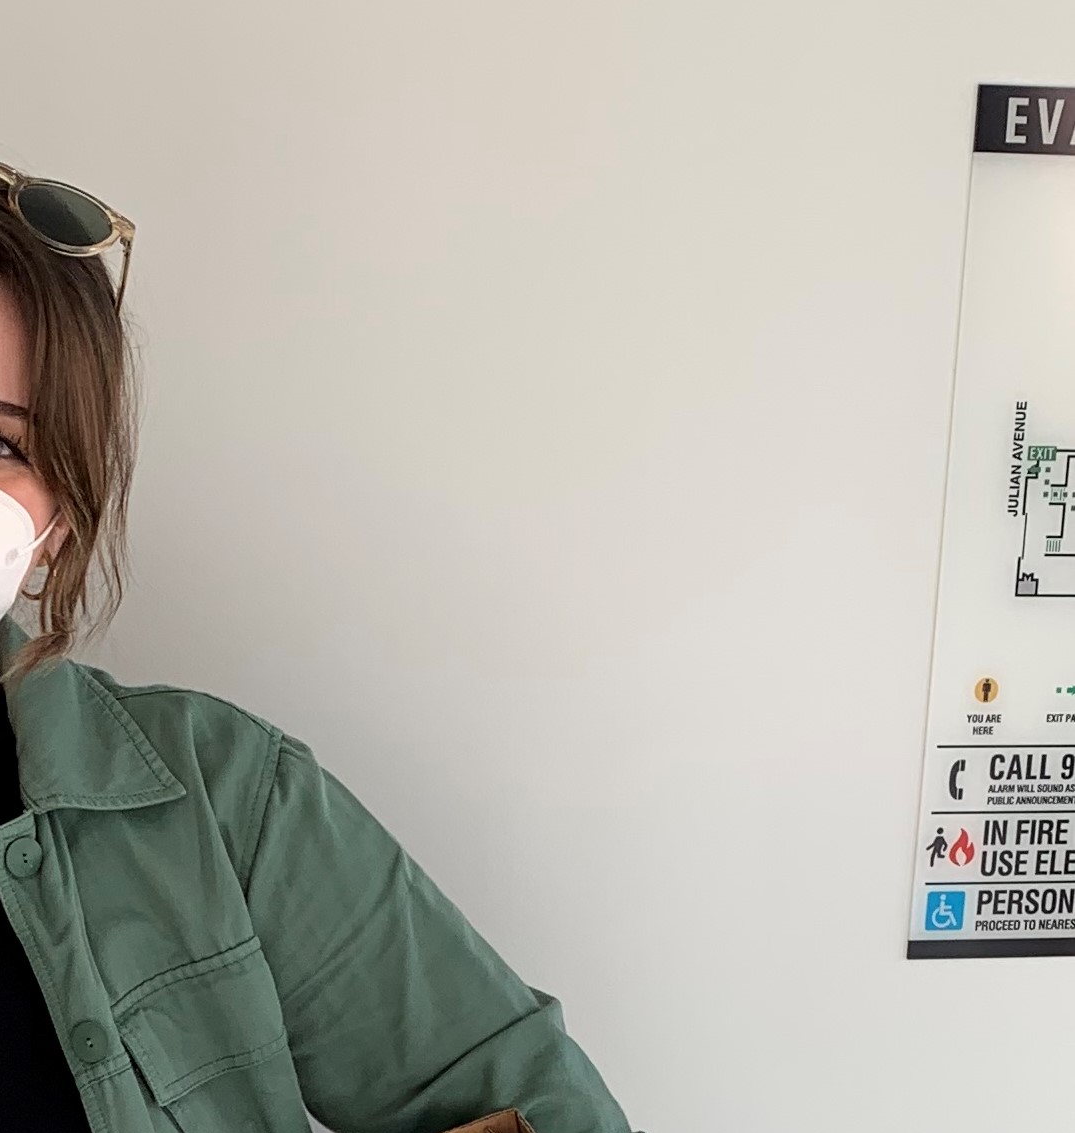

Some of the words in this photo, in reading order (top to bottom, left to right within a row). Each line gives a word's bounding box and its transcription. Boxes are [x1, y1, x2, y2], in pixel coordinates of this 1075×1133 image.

[1005, 96, 1075, 145] EV
[1012, 400, 1028, 461] AVENUE
[1030, 448, 1055, 460] EXIT
[1006, 463, 1023, 517] JULIAN
[966, 714, 984, 724] YOU
[986, 714, 1002, 723] ARE
[1046, 713, 1064, 723] EXIT
[972, 726, 994, 735] HERE
[989, 753, 1052, 780] CALL
[1061, 753, 1075, 780] 9
[988, 784, 1015, 793] ALARM
[1016, 784, 1035, 792] WILL
[1037, 784, 1064, 792] SOUND
[987, 797, 1014, 805] PUBLIC
[982, 819, 1008, 846] IN
[1015, 818, 1069, 845] FIRE
[980, 850, 1029, 876] USE
[974, 920, 1021, 931] PROCEED
[1024, 920, 1036, 930] TO
